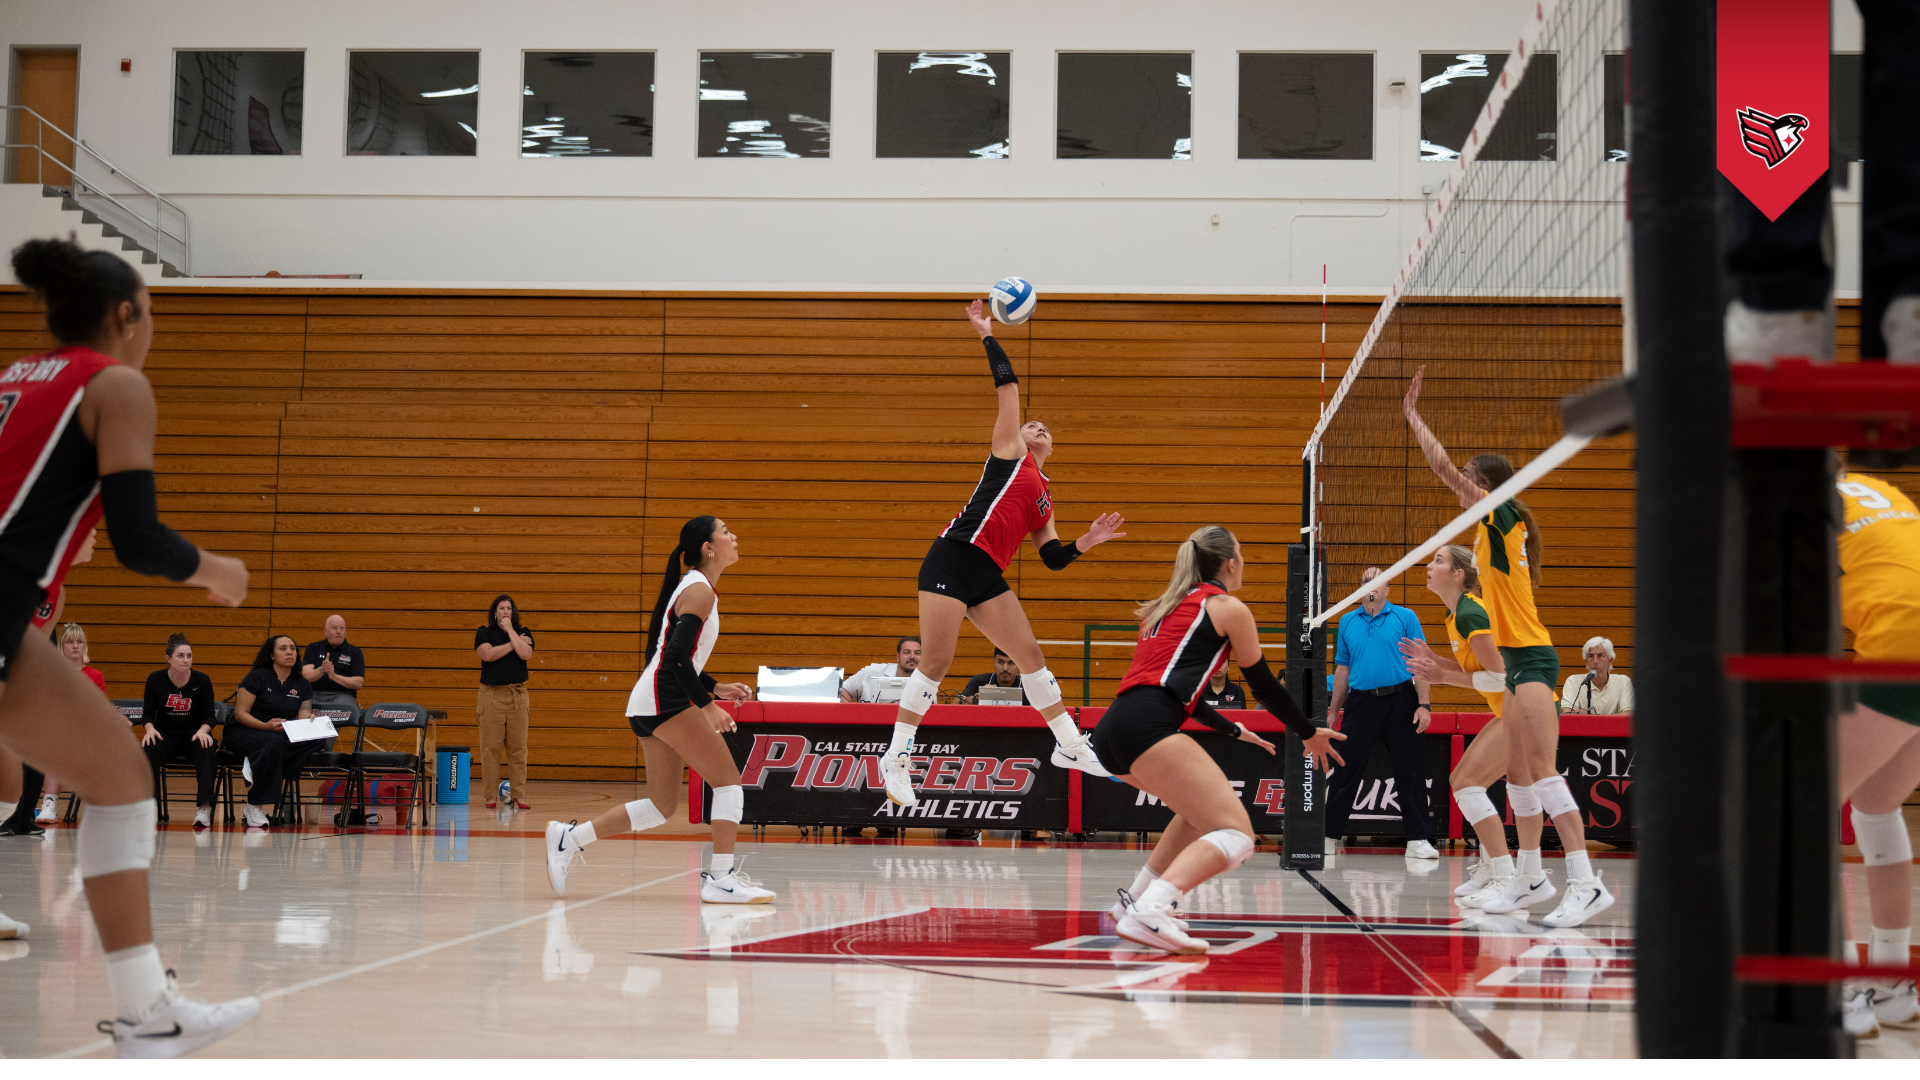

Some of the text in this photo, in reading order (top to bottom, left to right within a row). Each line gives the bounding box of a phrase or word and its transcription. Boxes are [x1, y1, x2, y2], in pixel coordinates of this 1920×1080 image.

[1835, 482, 1893, 509] 9
[165, 693, 193, 712] EB
[814, 742, 841, 752] CAL
[844, 742, 888, 753] STATE
[929, 743, 960, 754] BAY
[1302, 770, 1313, 812] imports
[872, 798, 1022, 820] ATHLETICS
